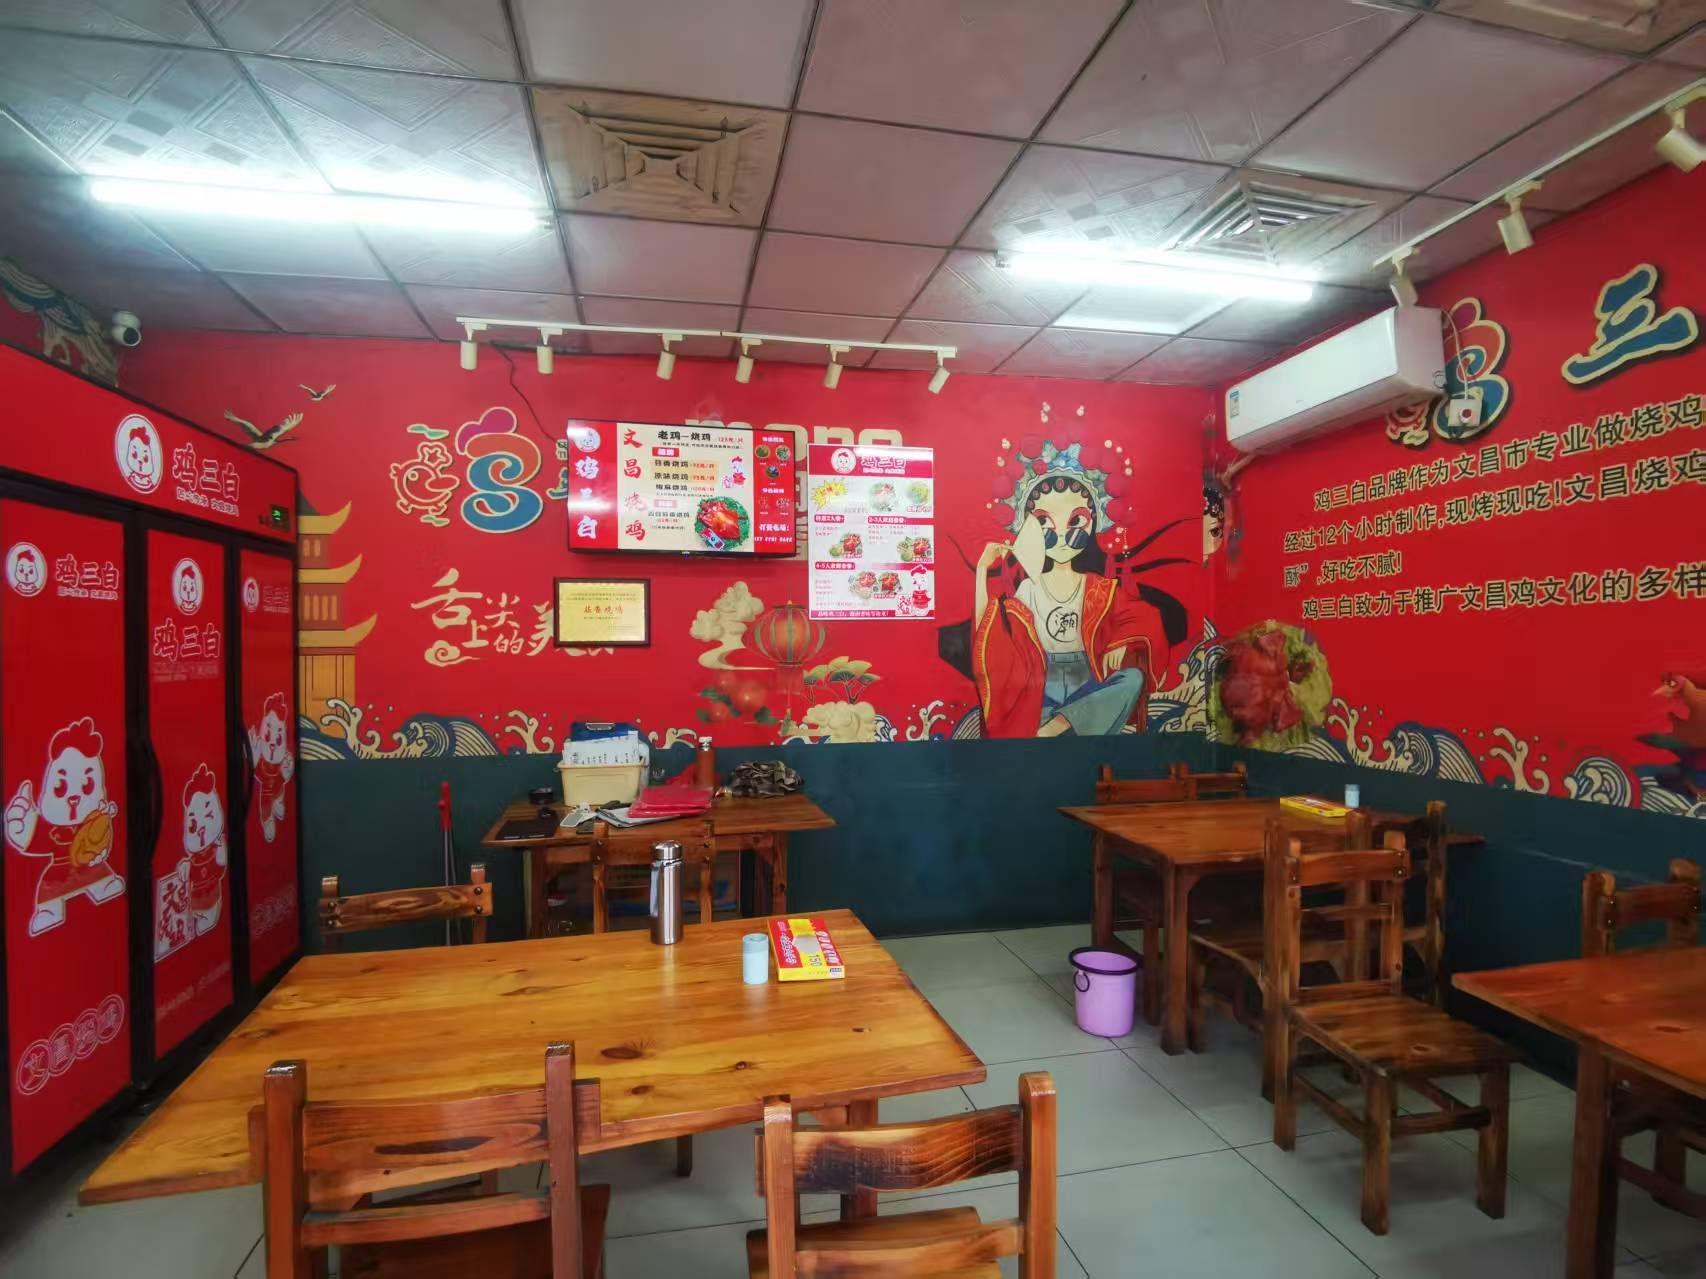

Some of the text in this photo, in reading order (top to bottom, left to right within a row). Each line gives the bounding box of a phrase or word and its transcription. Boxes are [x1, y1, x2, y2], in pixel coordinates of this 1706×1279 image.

[172, 442, 240, 501] 鸡三白
[56, 553, 119, 589] 鸡三白
[153, 617, 221, 661] 鸡三白
